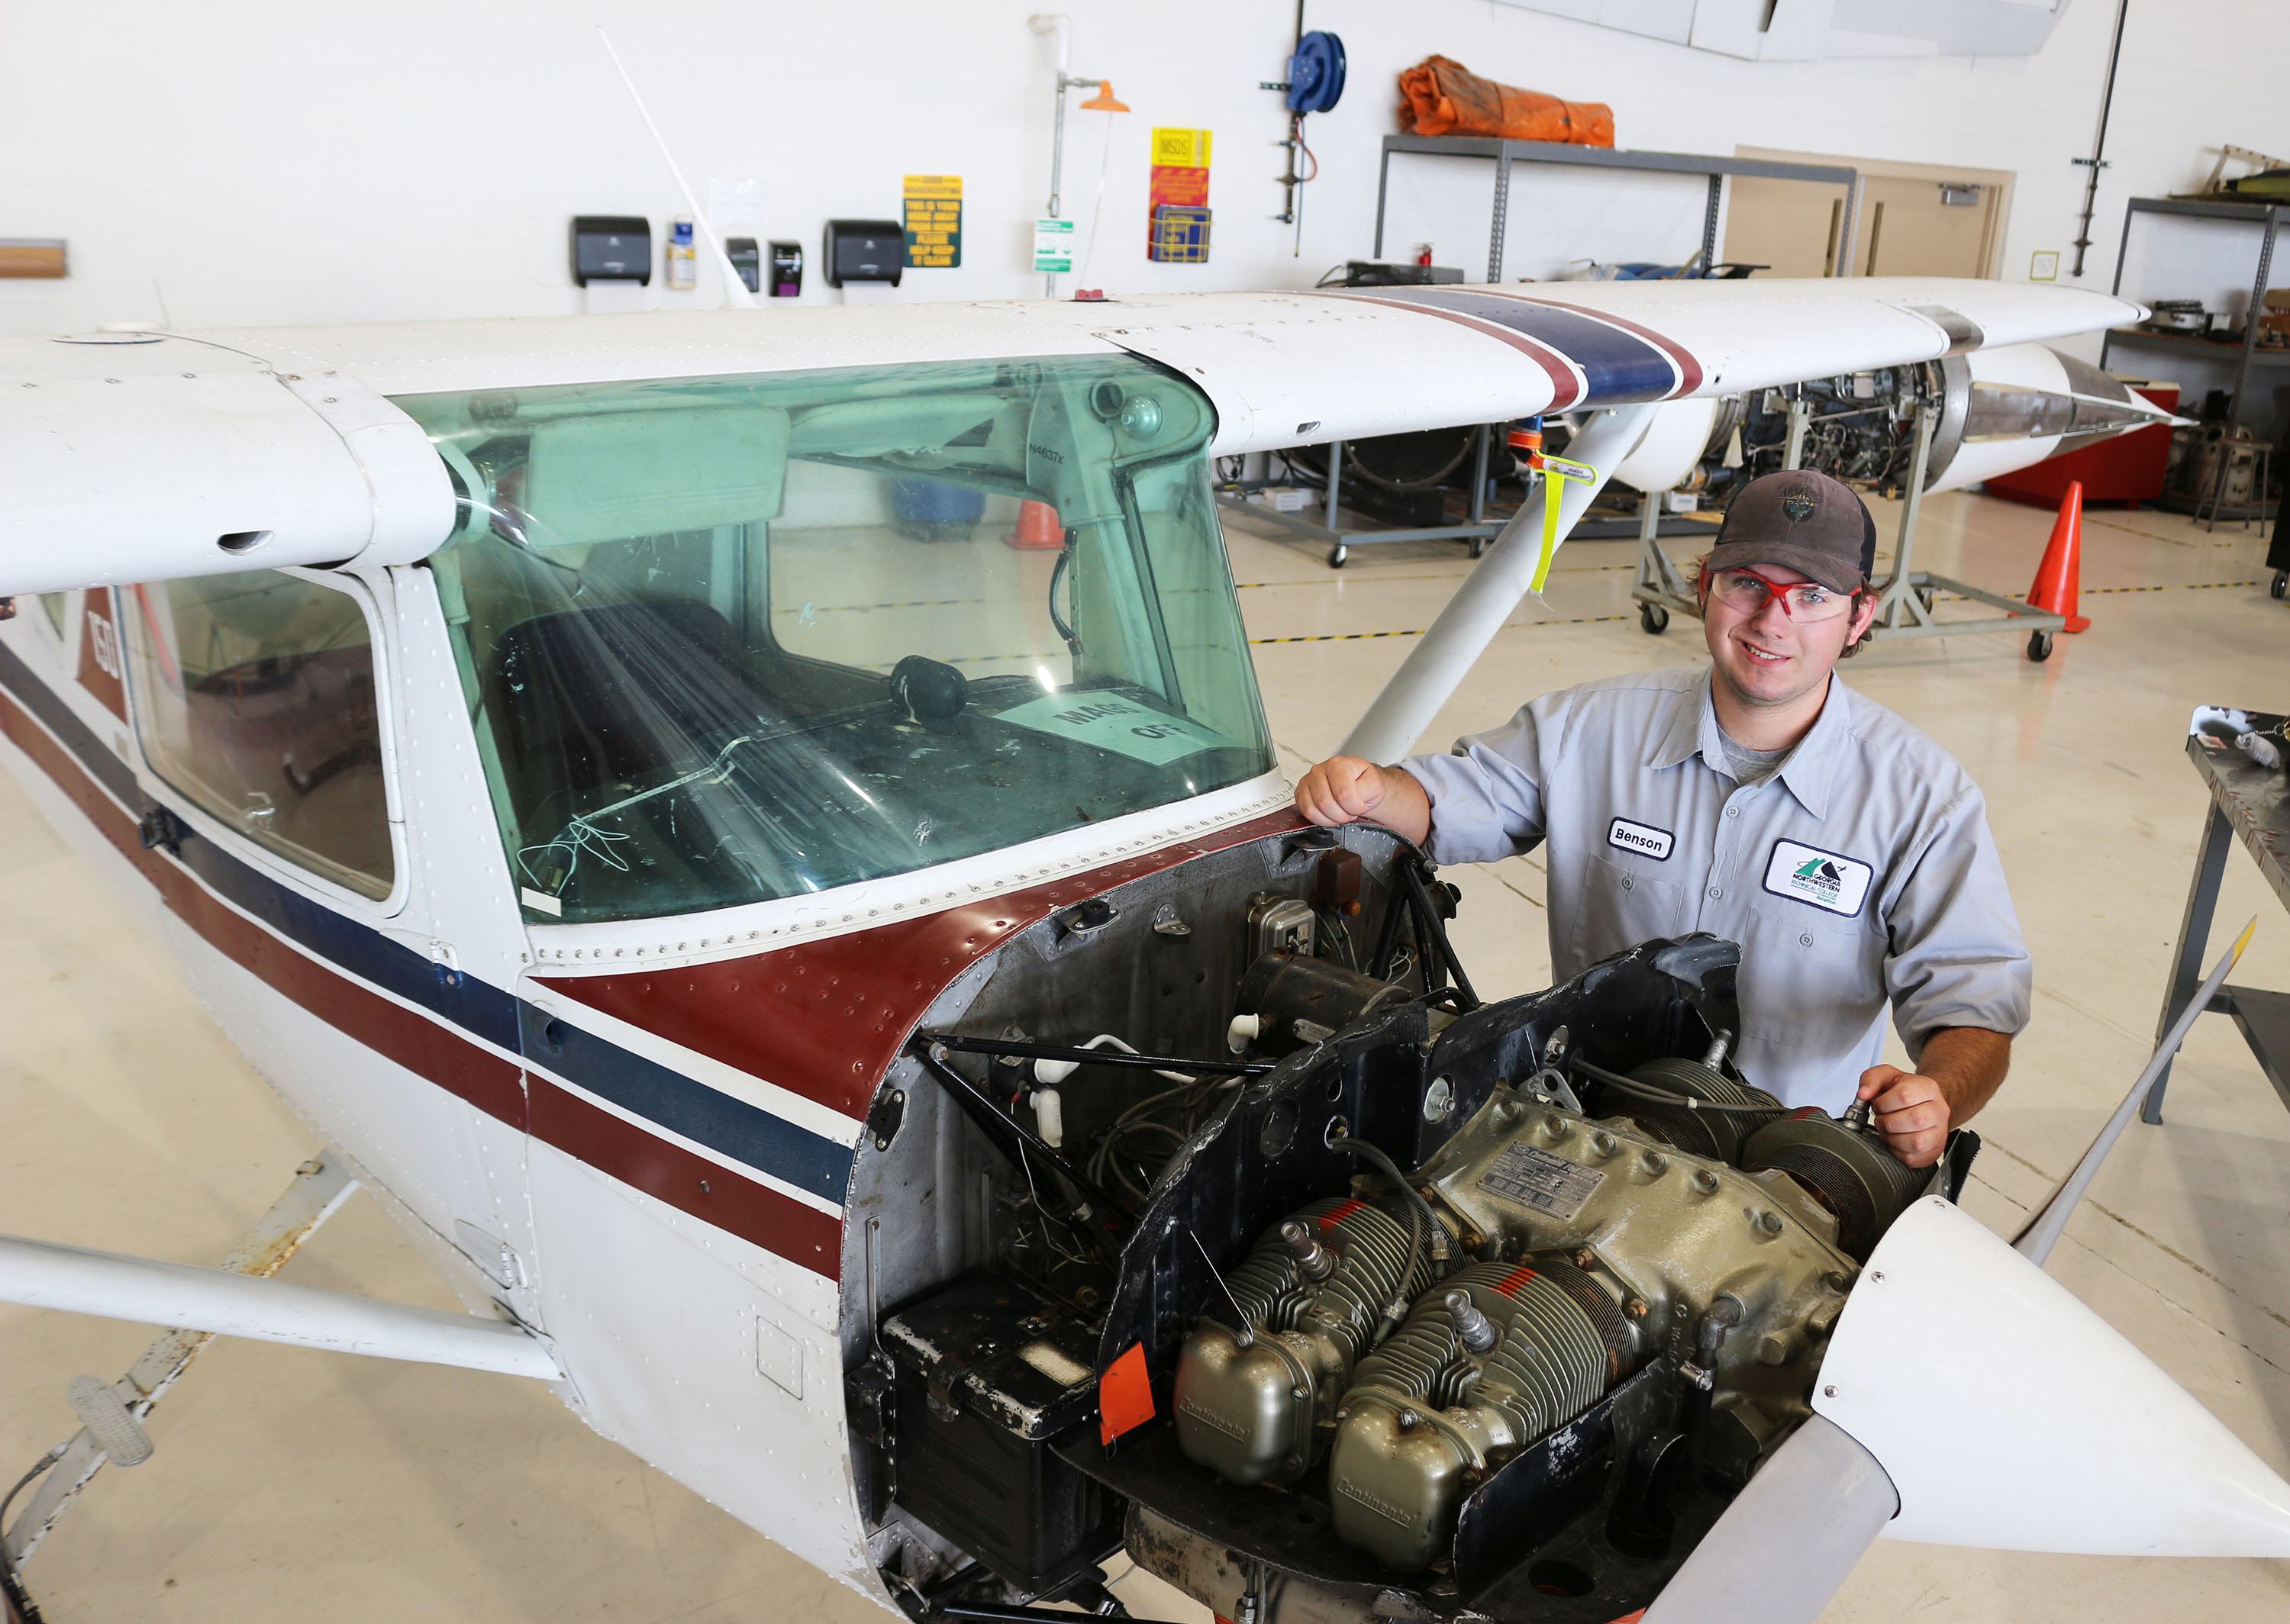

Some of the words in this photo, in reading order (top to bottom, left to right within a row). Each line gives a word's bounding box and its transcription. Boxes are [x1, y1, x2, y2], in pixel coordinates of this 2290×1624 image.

[905, 201, 924, 210] THIS
[937, 201, 960, 211] YOUR
[906, 211, 932, 221] HOME
[933, 211, 959, 221] AWAY
[906, 221, 931, 231] FROM
[933, 222, 958, 232] HOME
[916, 234, 949, 244] PLEASE
[909, 245, 931, 255] HELP
[932, 245, 956, 256] KEEP
[914, 256, 922, 266] IT
[923, 256, 952, 266] CLEAN
[1029, 443, 1064, 465] N4637X
[1052, 703, 1141, 725] MAGS
[1130, 723, 1189, 739] OFF
[1615, 828, 1662, 852] Benson
[1792, 873, 1840, 893] NORTHWESTERN
[1814, 873, 1841, 887] GEORGIA
[1791, 879, 1816, 892] TECHNICAL
[1816, 888, 1839, 898] COLLEGE
[1179, 1397, 1251, 1442] Continental
[1337, 1477, 1417, 1529] Continental
